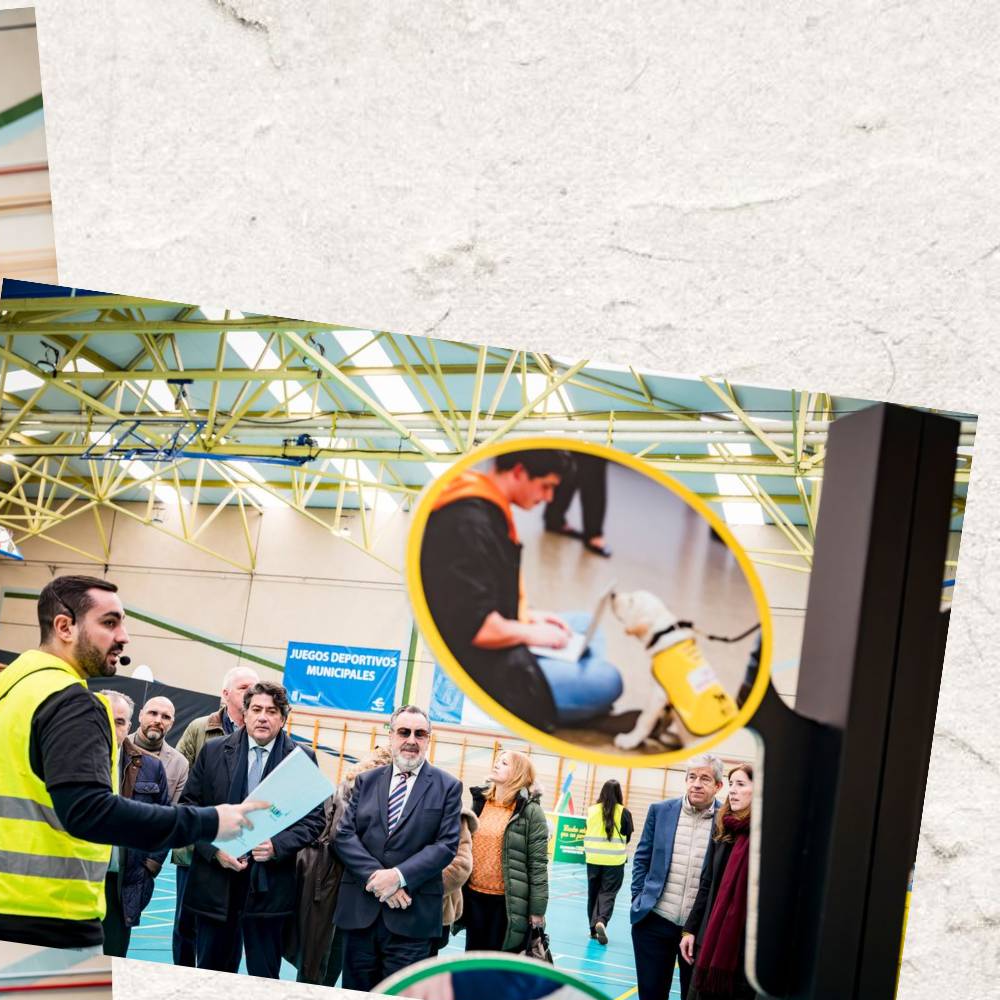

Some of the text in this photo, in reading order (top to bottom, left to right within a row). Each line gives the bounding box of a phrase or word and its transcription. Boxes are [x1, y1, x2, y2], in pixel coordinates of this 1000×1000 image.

[290, 649, 397, 668] JUEGOS DEPORTIVOS
[306, 664, 376, 682] MUNICIPALES
